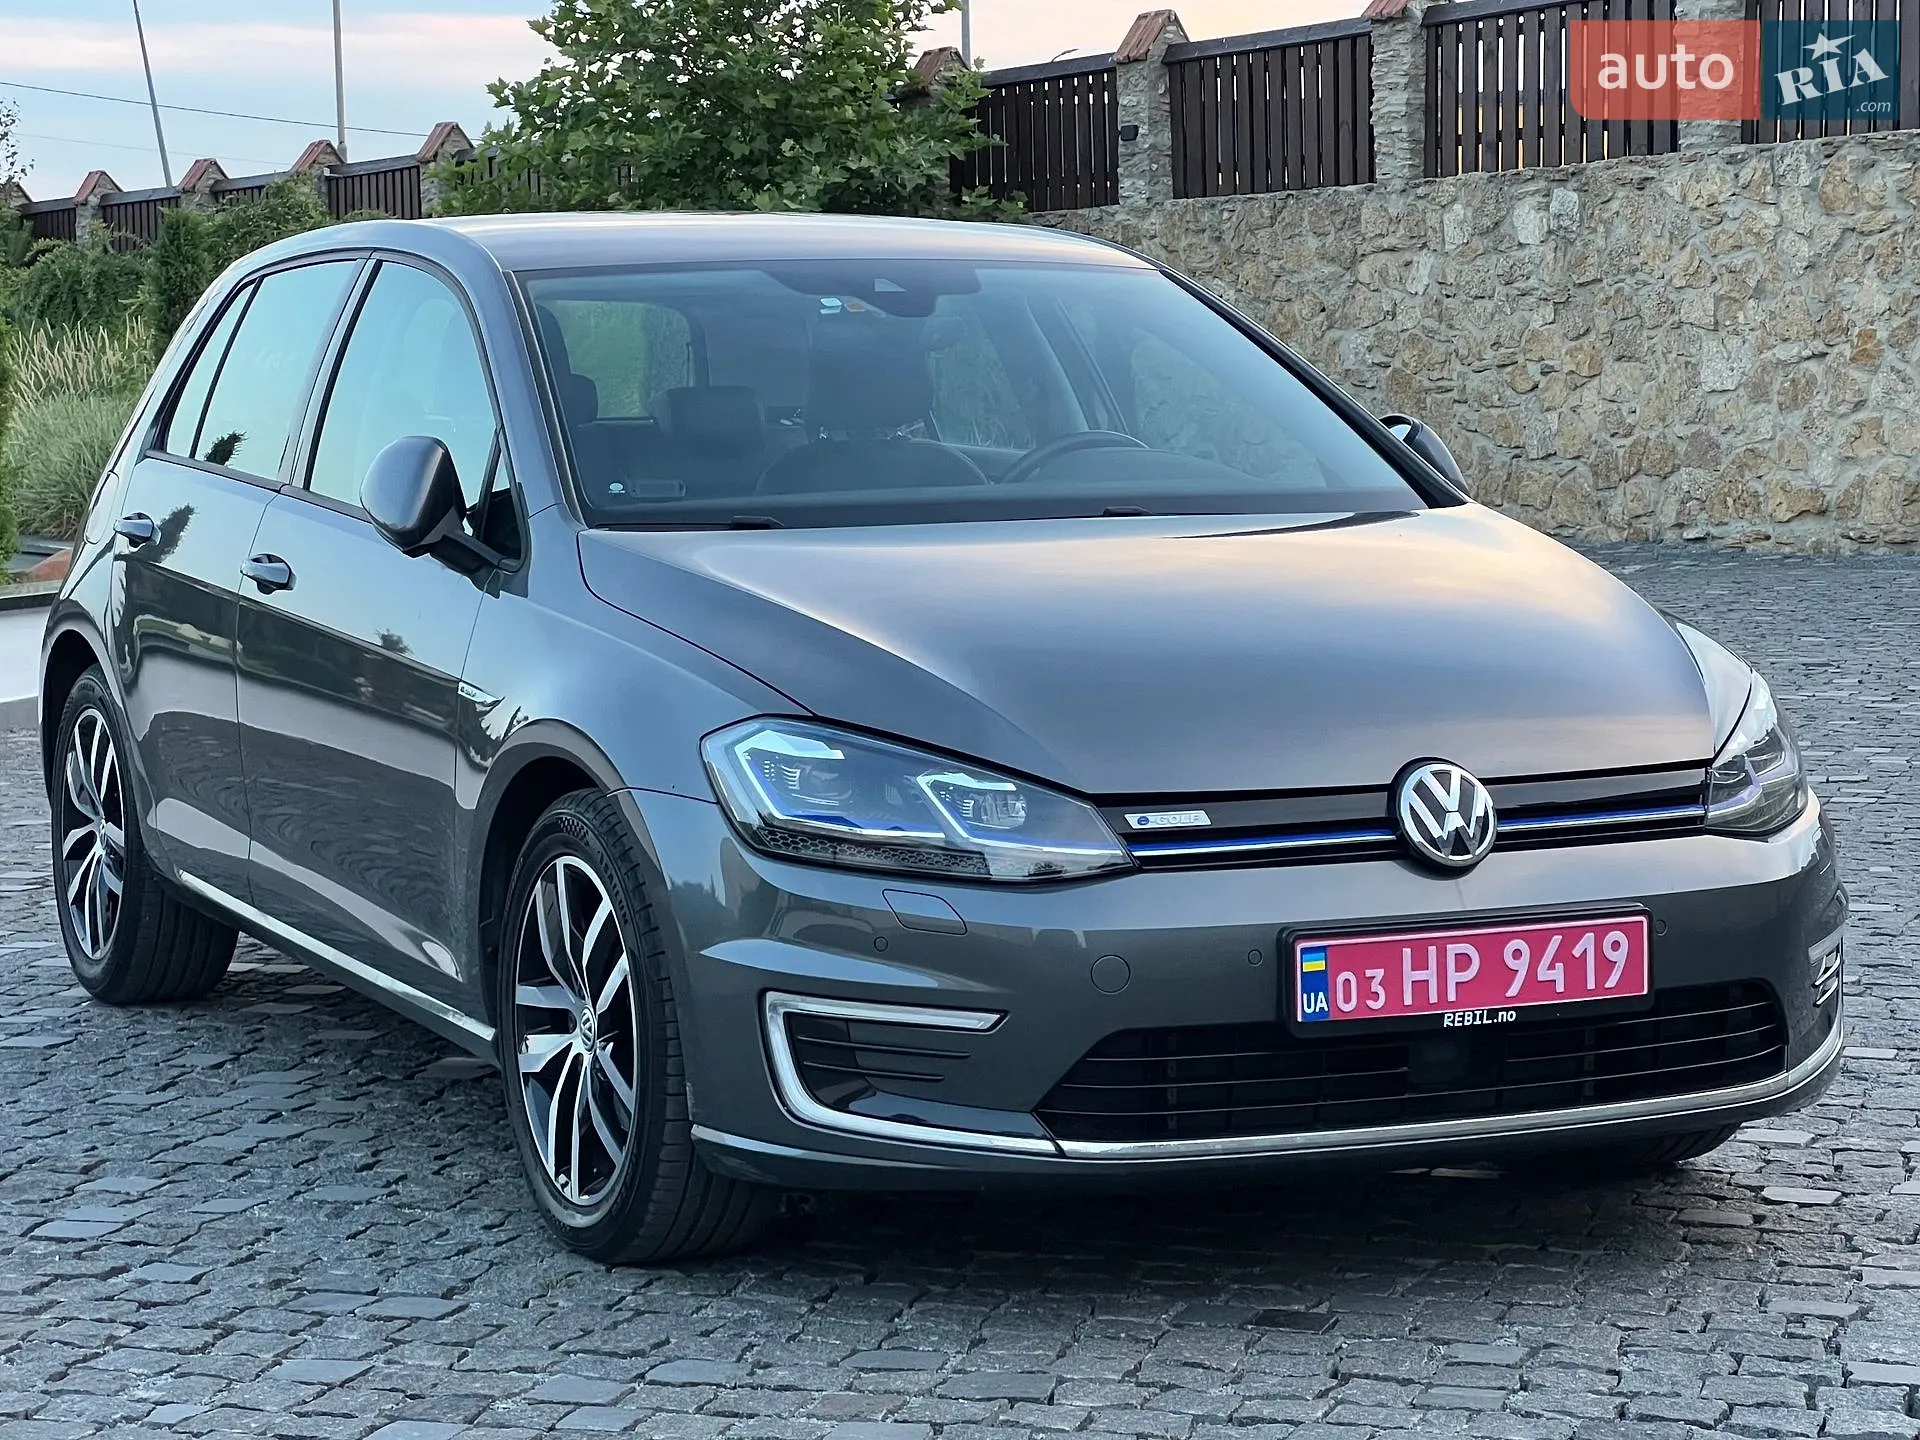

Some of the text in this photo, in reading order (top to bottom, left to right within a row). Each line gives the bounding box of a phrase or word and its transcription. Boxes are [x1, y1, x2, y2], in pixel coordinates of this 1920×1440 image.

[1401, 763, 1495, 866] VW
[1336, 930, 1629, 1013] 03 HP 9419
[1303, 991, 1329, 1014] UA
[1444, 1010, 1517, 1028] REBIL.no
